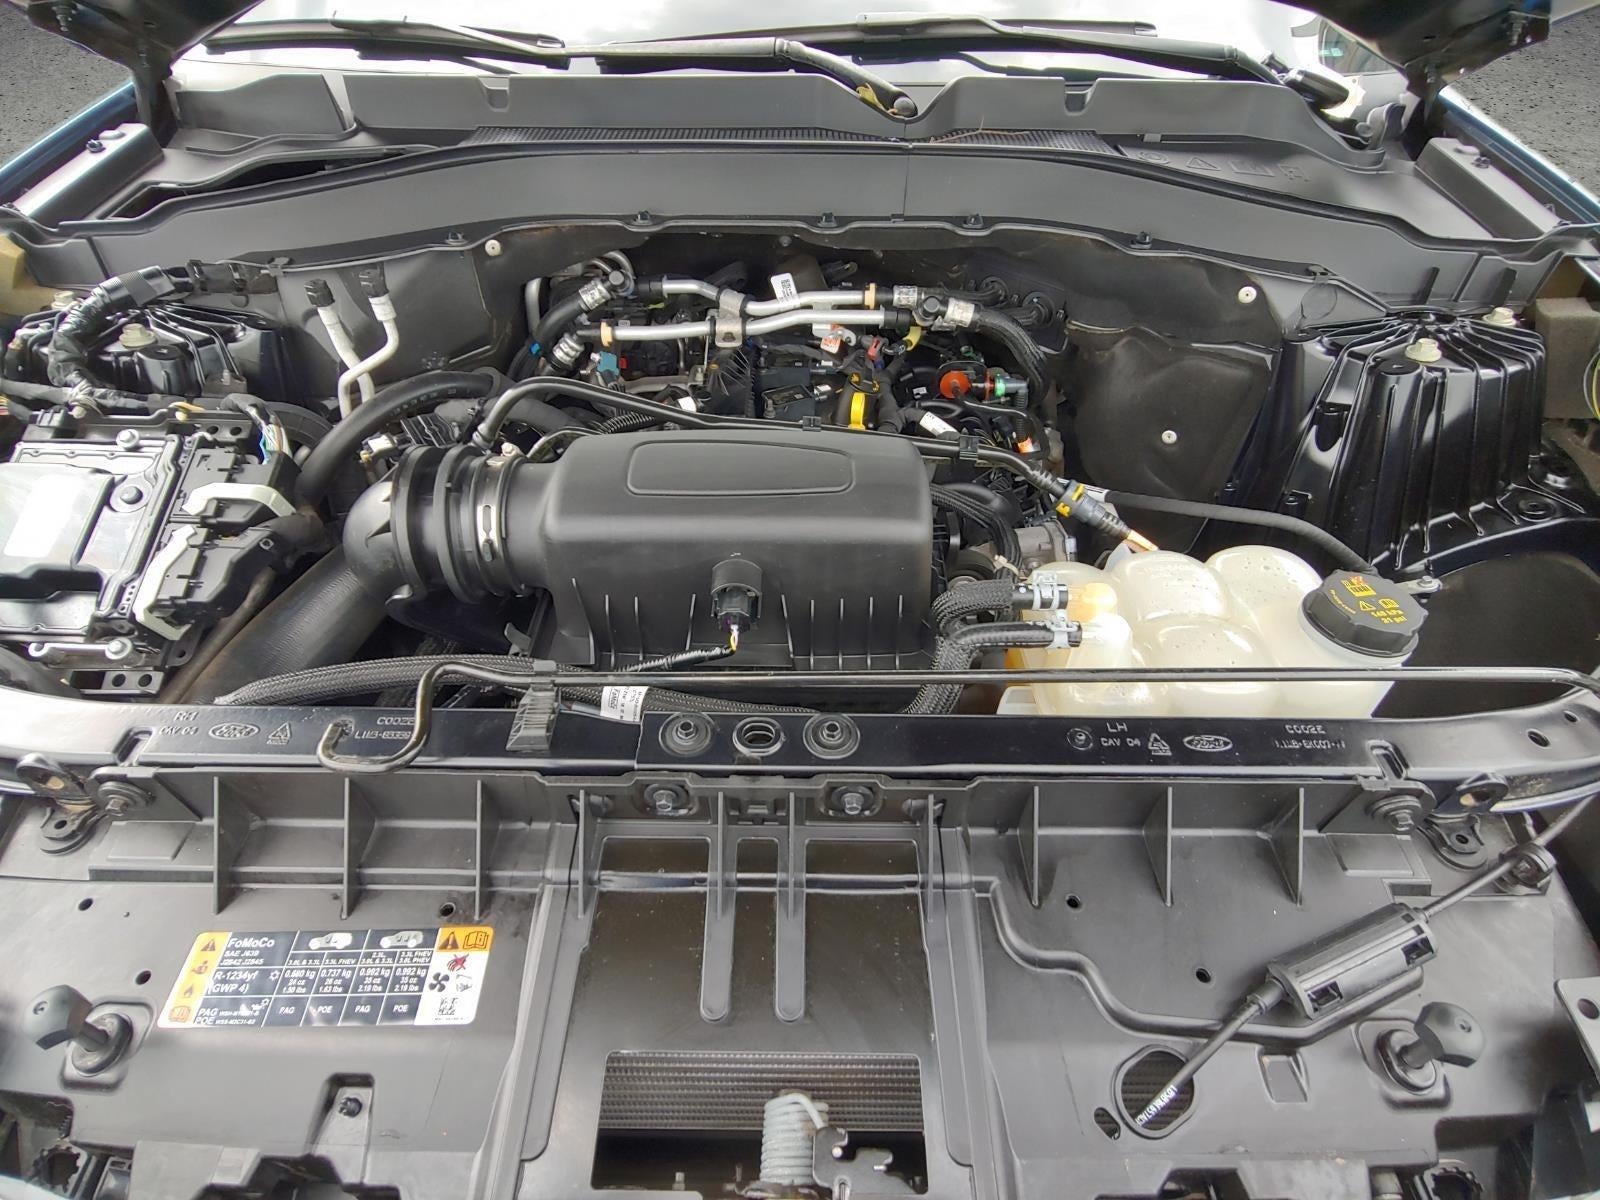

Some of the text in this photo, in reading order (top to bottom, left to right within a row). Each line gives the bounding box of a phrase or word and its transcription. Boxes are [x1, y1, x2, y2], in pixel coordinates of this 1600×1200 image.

[1106, 722, 1128, 732] LH
[1100, 737, 1141, 747] CAV 04
[1187, 736, 1229, 750] Ford
[227, 936, 275, 948] FoMoCo
[213, 970, 258, 982] R-1234yf
[306, 969, 316, 980] kg
[320, 969, 352, 979] 0.737 kg
[381, 968, 391, 978] kg
[417, 967, 427, 977] kg
[207, 984, 250, 995] (GWP 4)
[371, 984, 382, 992] lbs
[408, 984, 419, 992] lbs
[198, 1008, 218, 1017] PAG
[279, 1006, 295, 1014] PAG
[317, 1005, 333, 1014] POE
[355, 1005, 371, 1013] PAG
[392, 1004, 409, 1012] POE
[194, 1017, 215, 1025] POE
